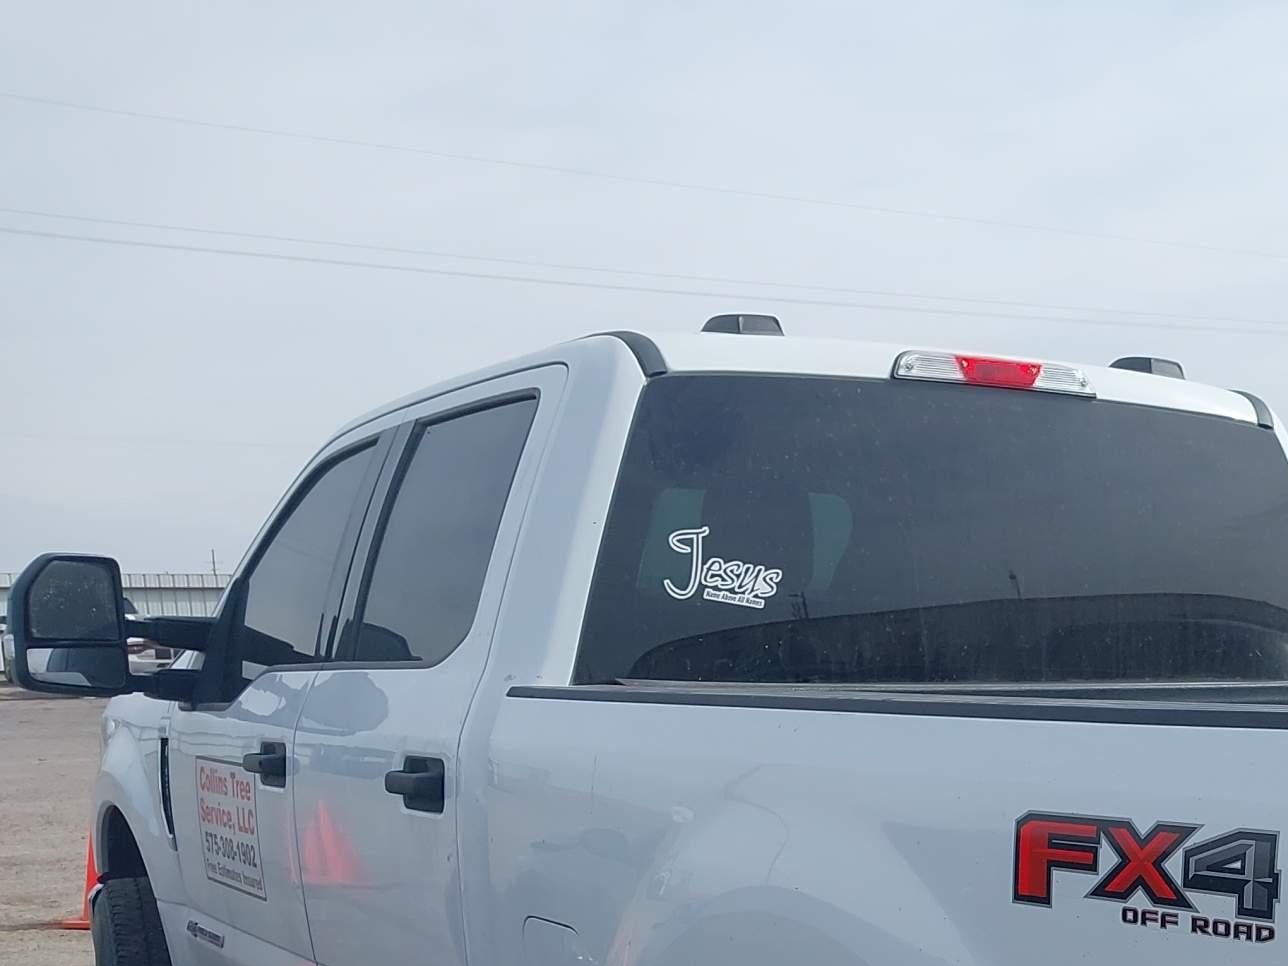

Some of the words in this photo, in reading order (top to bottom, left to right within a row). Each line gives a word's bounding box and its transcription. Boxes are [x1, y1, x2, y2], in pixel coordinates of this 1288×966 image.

[663, 526, 782, 600] Jesus
[200, 766, 228, 796] Collins
[230, 771, 251, 801] Tree
[200, 797, 237, 835] Service,
[237, 806, 255, 836] LLC
[1012, 810, 1281, 923] FX4
[1121, 907, 1179, 930] OFF
[1190, 915, 1276, 944] ROAD
